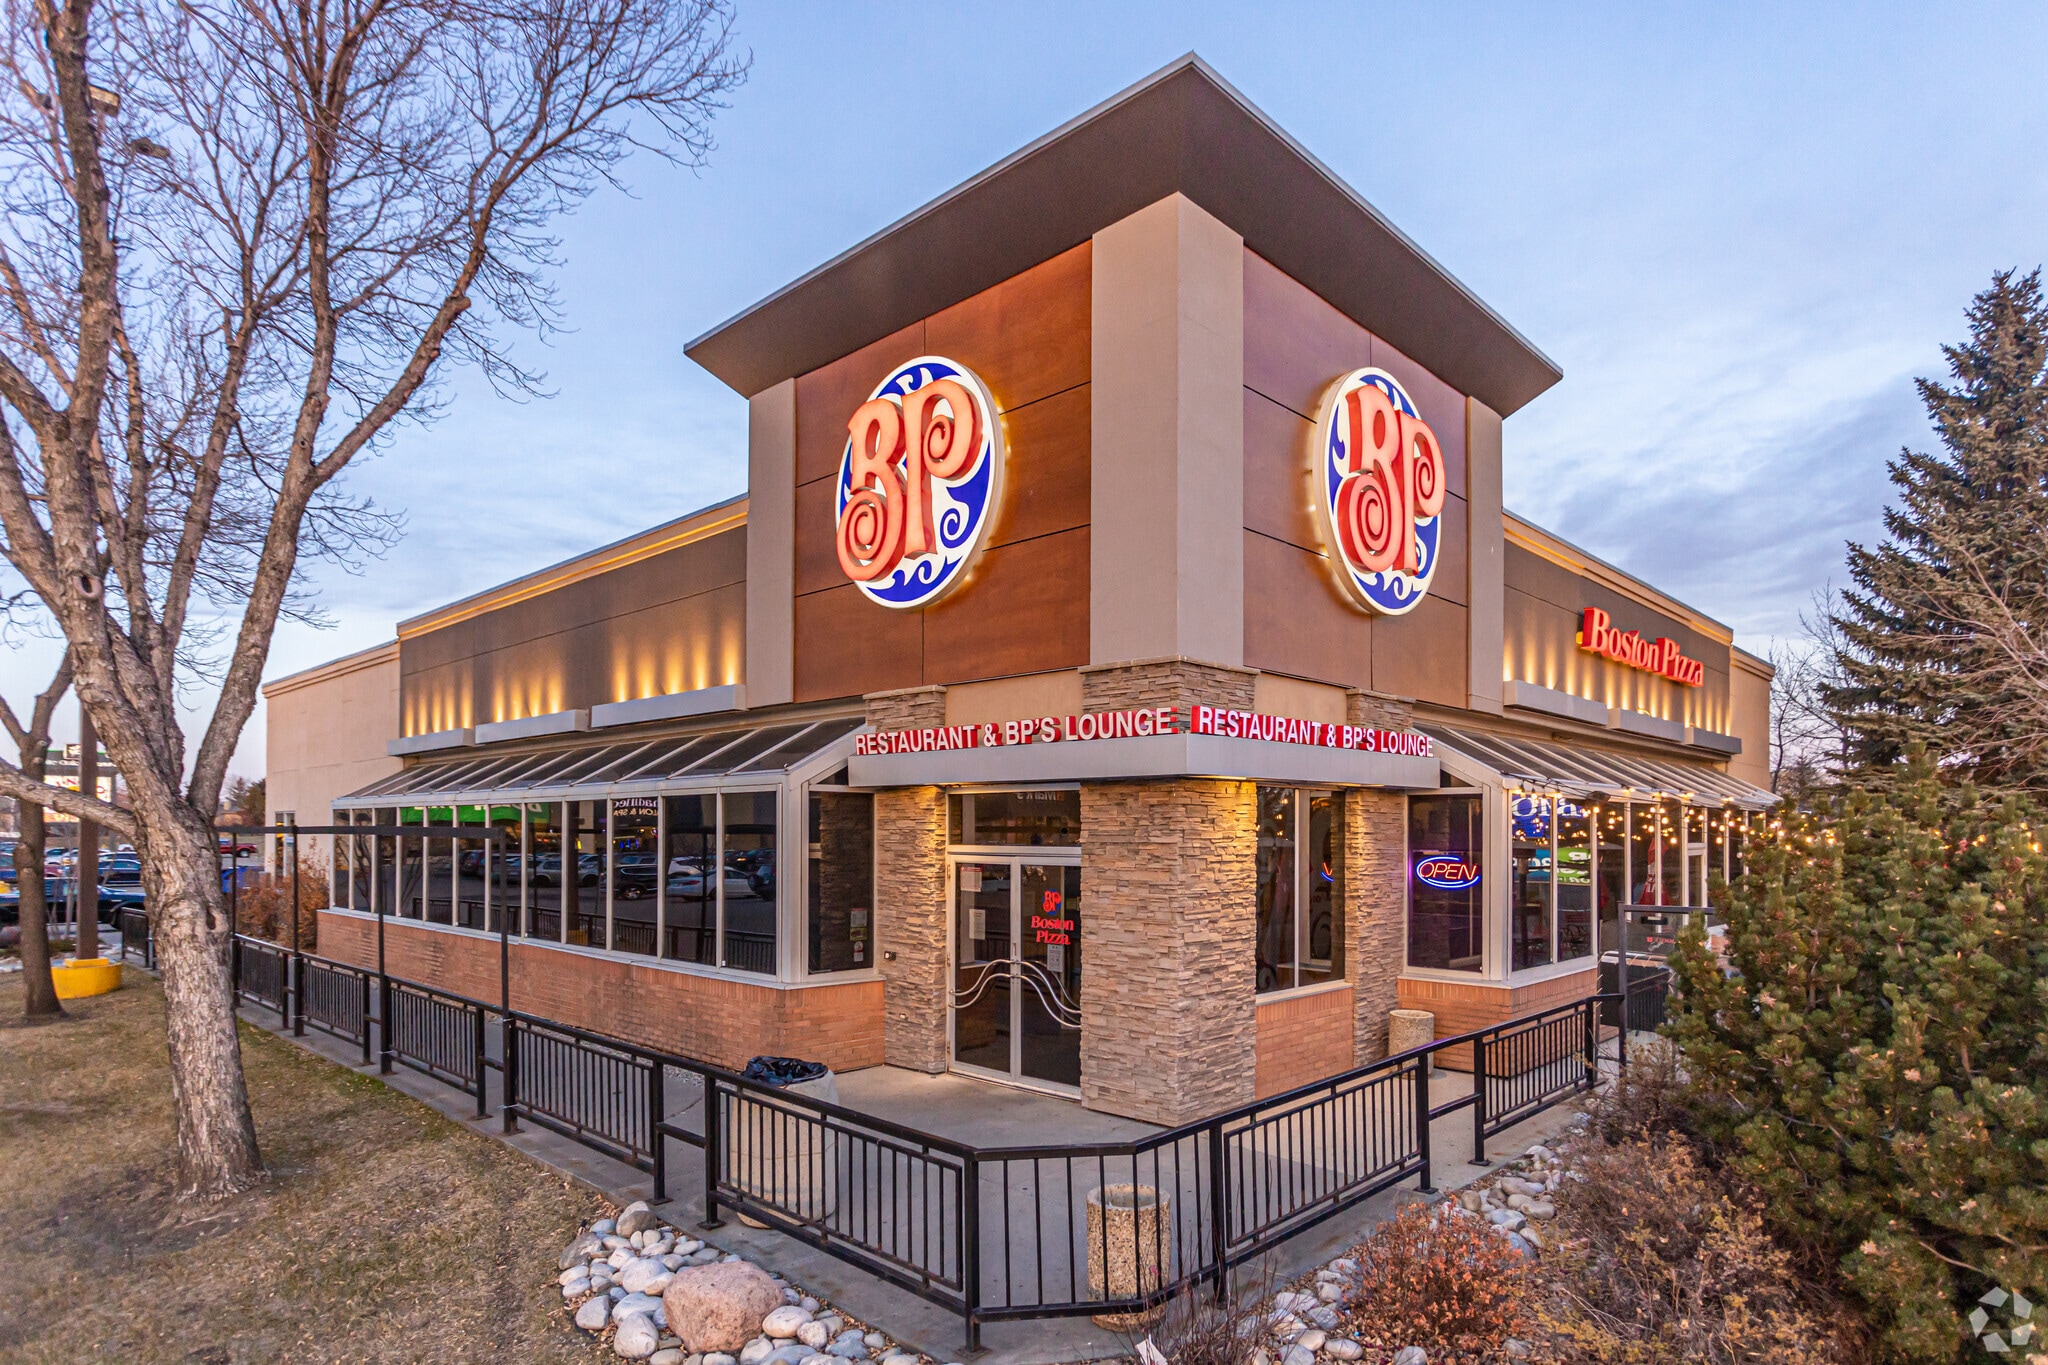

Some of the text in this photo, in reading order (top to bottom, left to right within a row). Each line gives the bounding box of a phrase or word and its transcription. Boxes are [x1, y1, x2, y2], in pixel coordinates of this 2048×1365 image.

[836, 378, 983, 582] BP
[1337, 383, 1446, 576] BP
[1582, 607, 1705, 688] Boston Pizza
[855, 706, 1178, 756] RESTAURANT & BP'S LOUNGE
[1195, 705, 1435, 758] RESTAURANT & BP'S LOUNGE
[1419, 862, 1477, 880] OPEN
[1031, 915, 1075, 931] Boston
